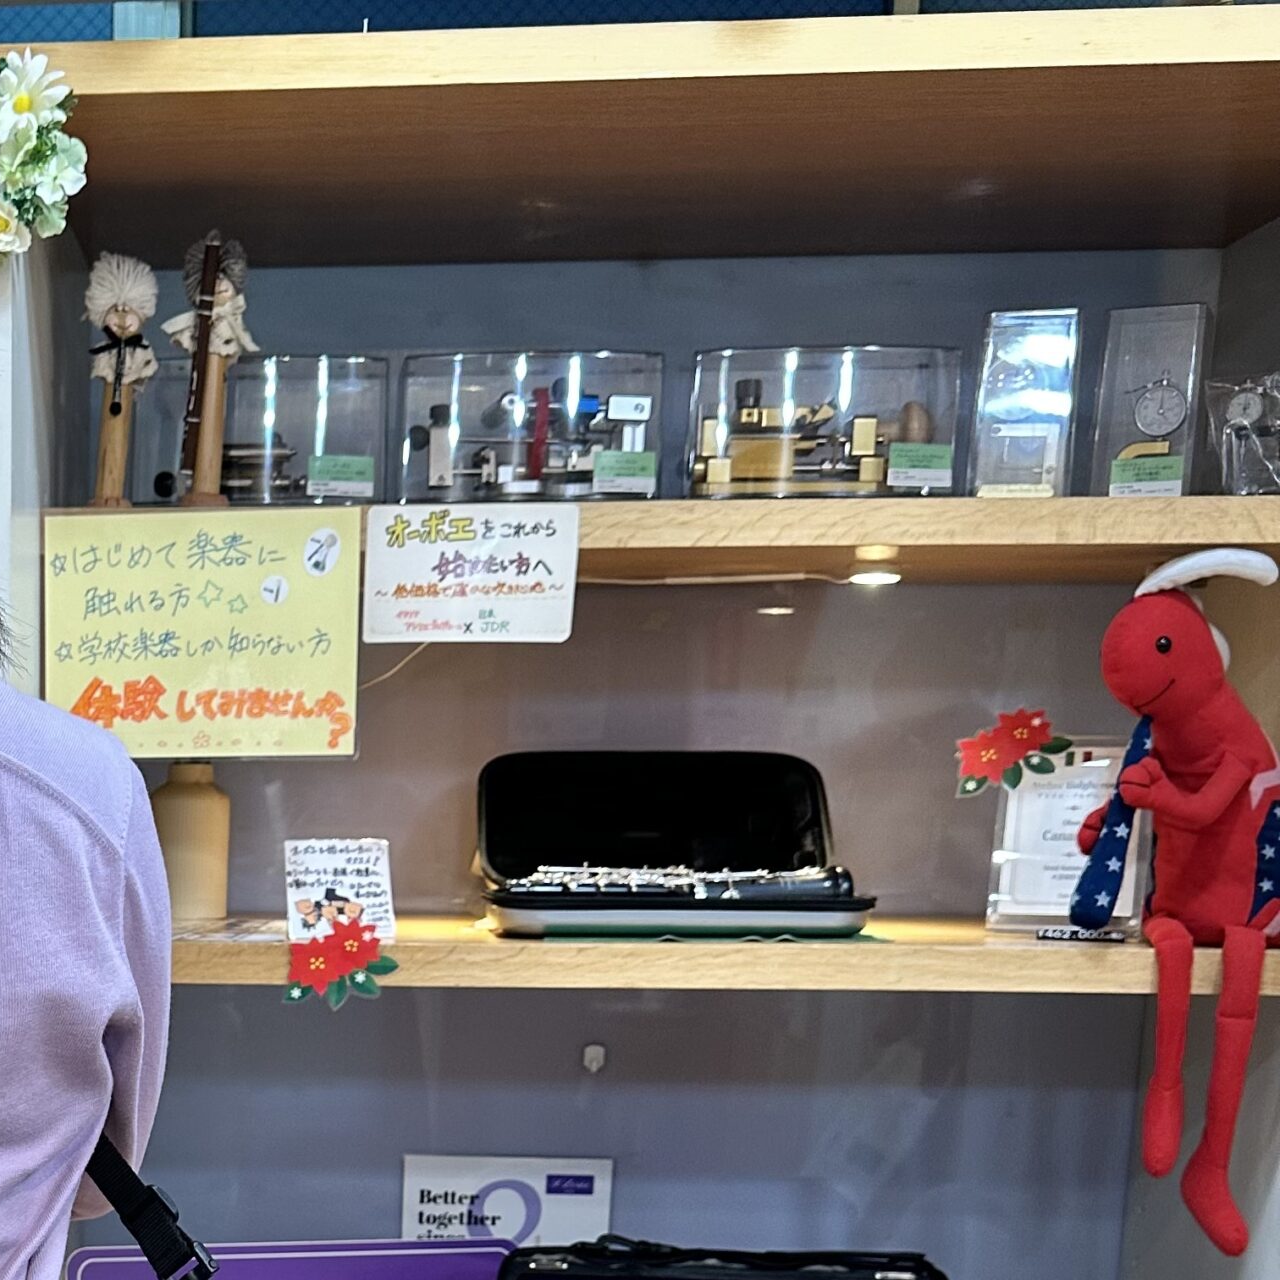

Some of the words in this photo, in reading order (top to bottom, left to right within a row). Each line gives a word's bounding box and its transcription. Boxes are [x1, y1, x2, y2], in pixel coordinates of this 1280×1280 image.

[72, 529, 287, 574] はじめて楽器に
[82, 583, 190, 620] 触れる方
[480, 621, 510, 634] JDR
[78, 627, 332, 666] 学校楽器しか知らない方
[419, 1189, 480, 1205] Better
[418, 1210, 501, 1230] together
